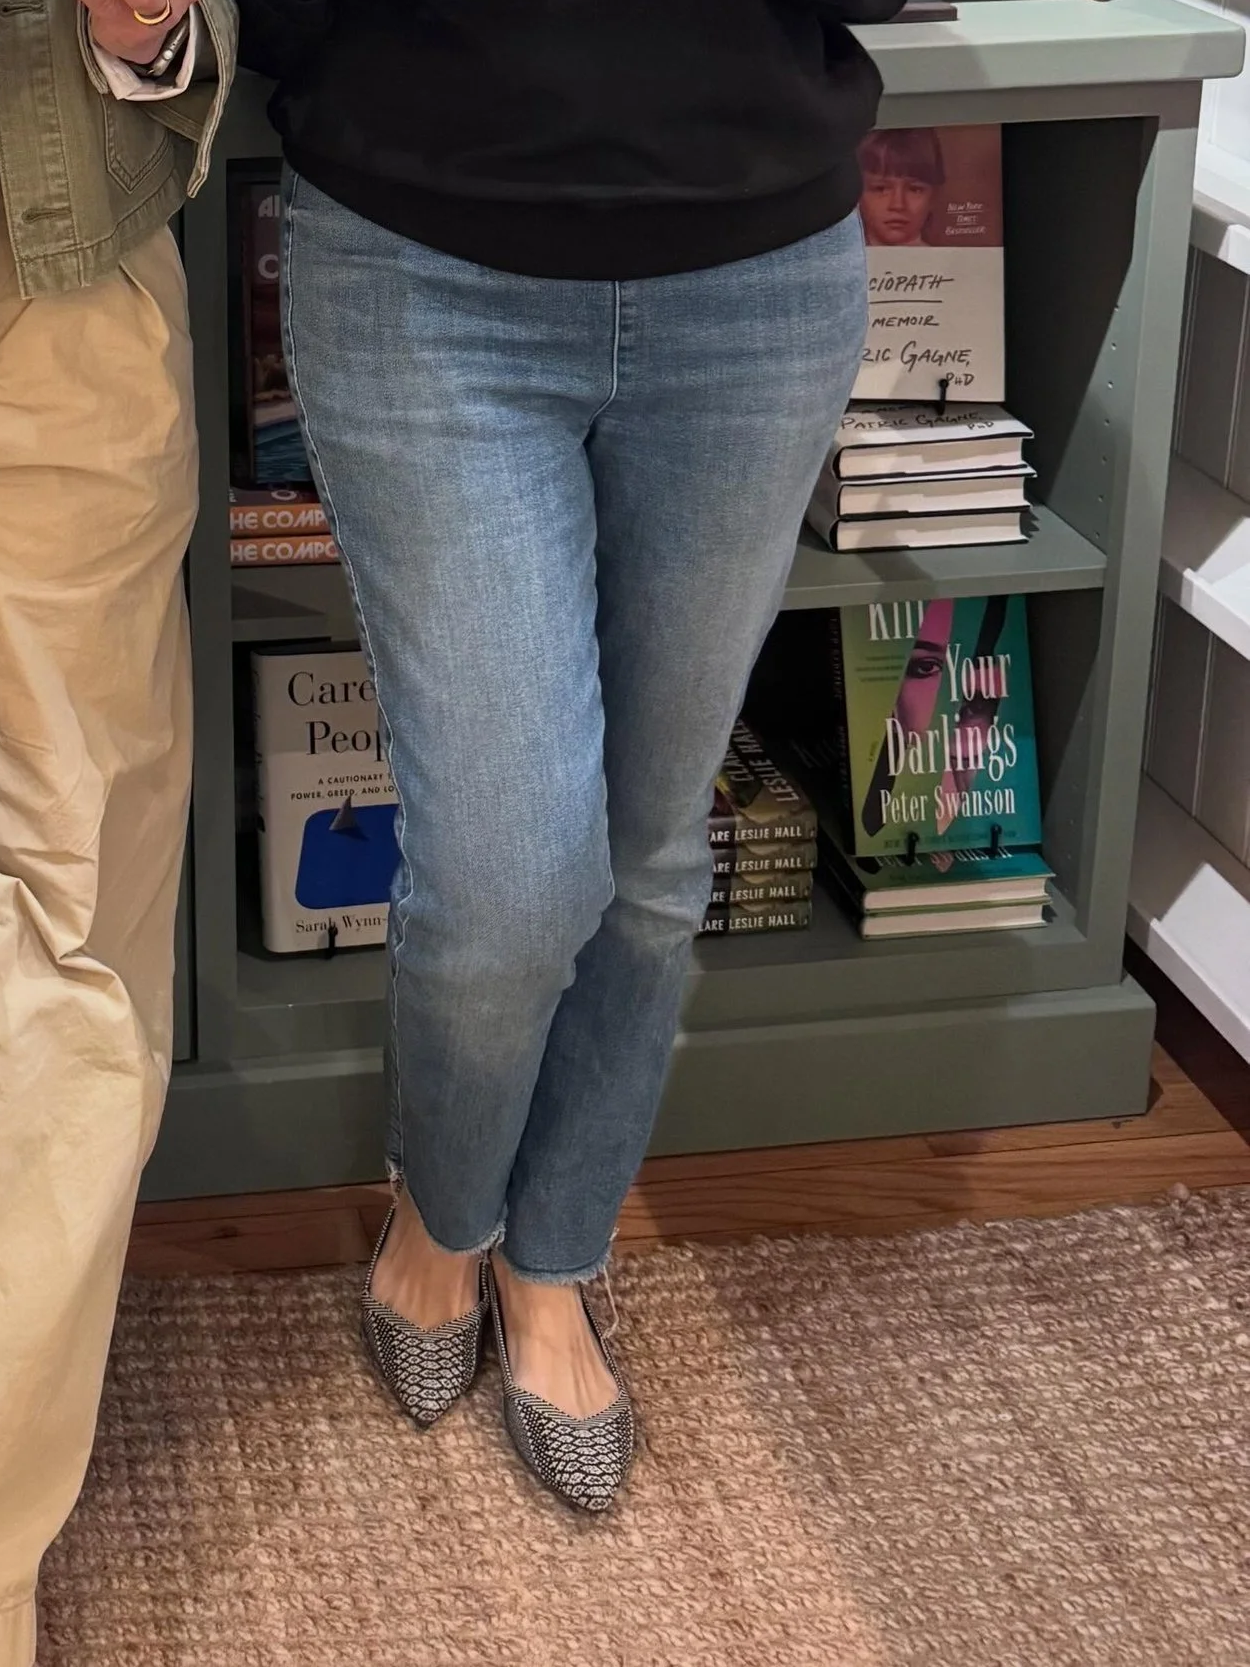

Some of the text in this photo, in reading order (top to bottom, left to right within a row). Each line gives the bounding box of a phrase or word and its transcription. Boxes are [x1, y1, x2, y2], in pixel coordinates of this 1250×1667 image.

[872, 315, 940, 328] MEMOIR
[900, 340, 971, 372] GAGNE,
[945, 643, 1011, 703] Your
[885, 714, 1018, 782] Darlings
[327, 773, 383, 786] CAUTIONARY
[290, 790, 324, 801] POWER,
[880, 785, 1016, 824] Peter Swanson
[735, 826, 802, 841] LESLIE HALL
